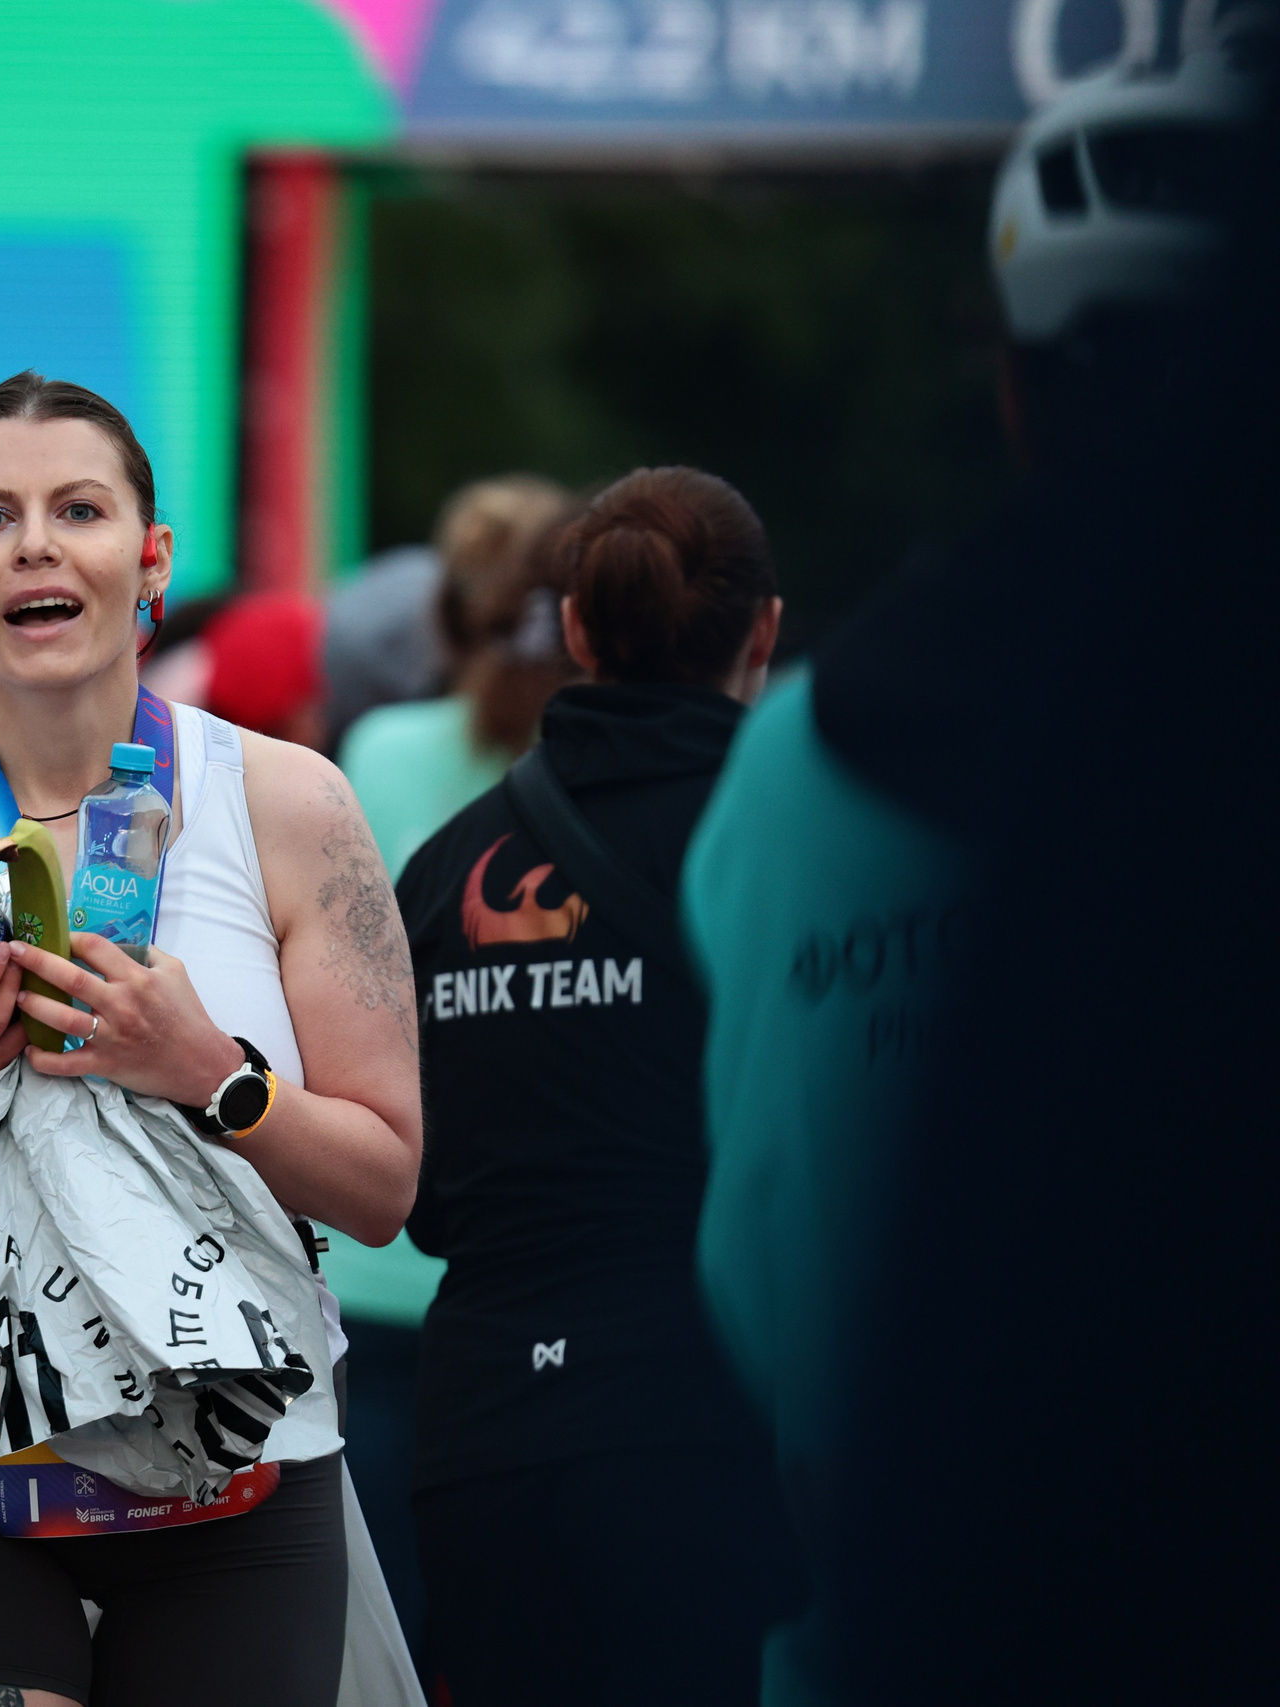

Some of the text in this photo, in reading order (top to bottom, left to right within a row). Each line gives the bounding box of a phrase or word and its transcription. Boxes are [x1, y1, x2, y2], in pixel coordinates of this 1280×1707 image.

[209, 718, 235, 749] NIKE
[80, 869, 138, 901] AQUA
[83, 896, 132, 910] MINERALE
[423, 957, 643, 1022] ENIX TEAM
[90, 1513, 115, 1523] BRICS
[126, 1504, 173, 1519] FONBET
